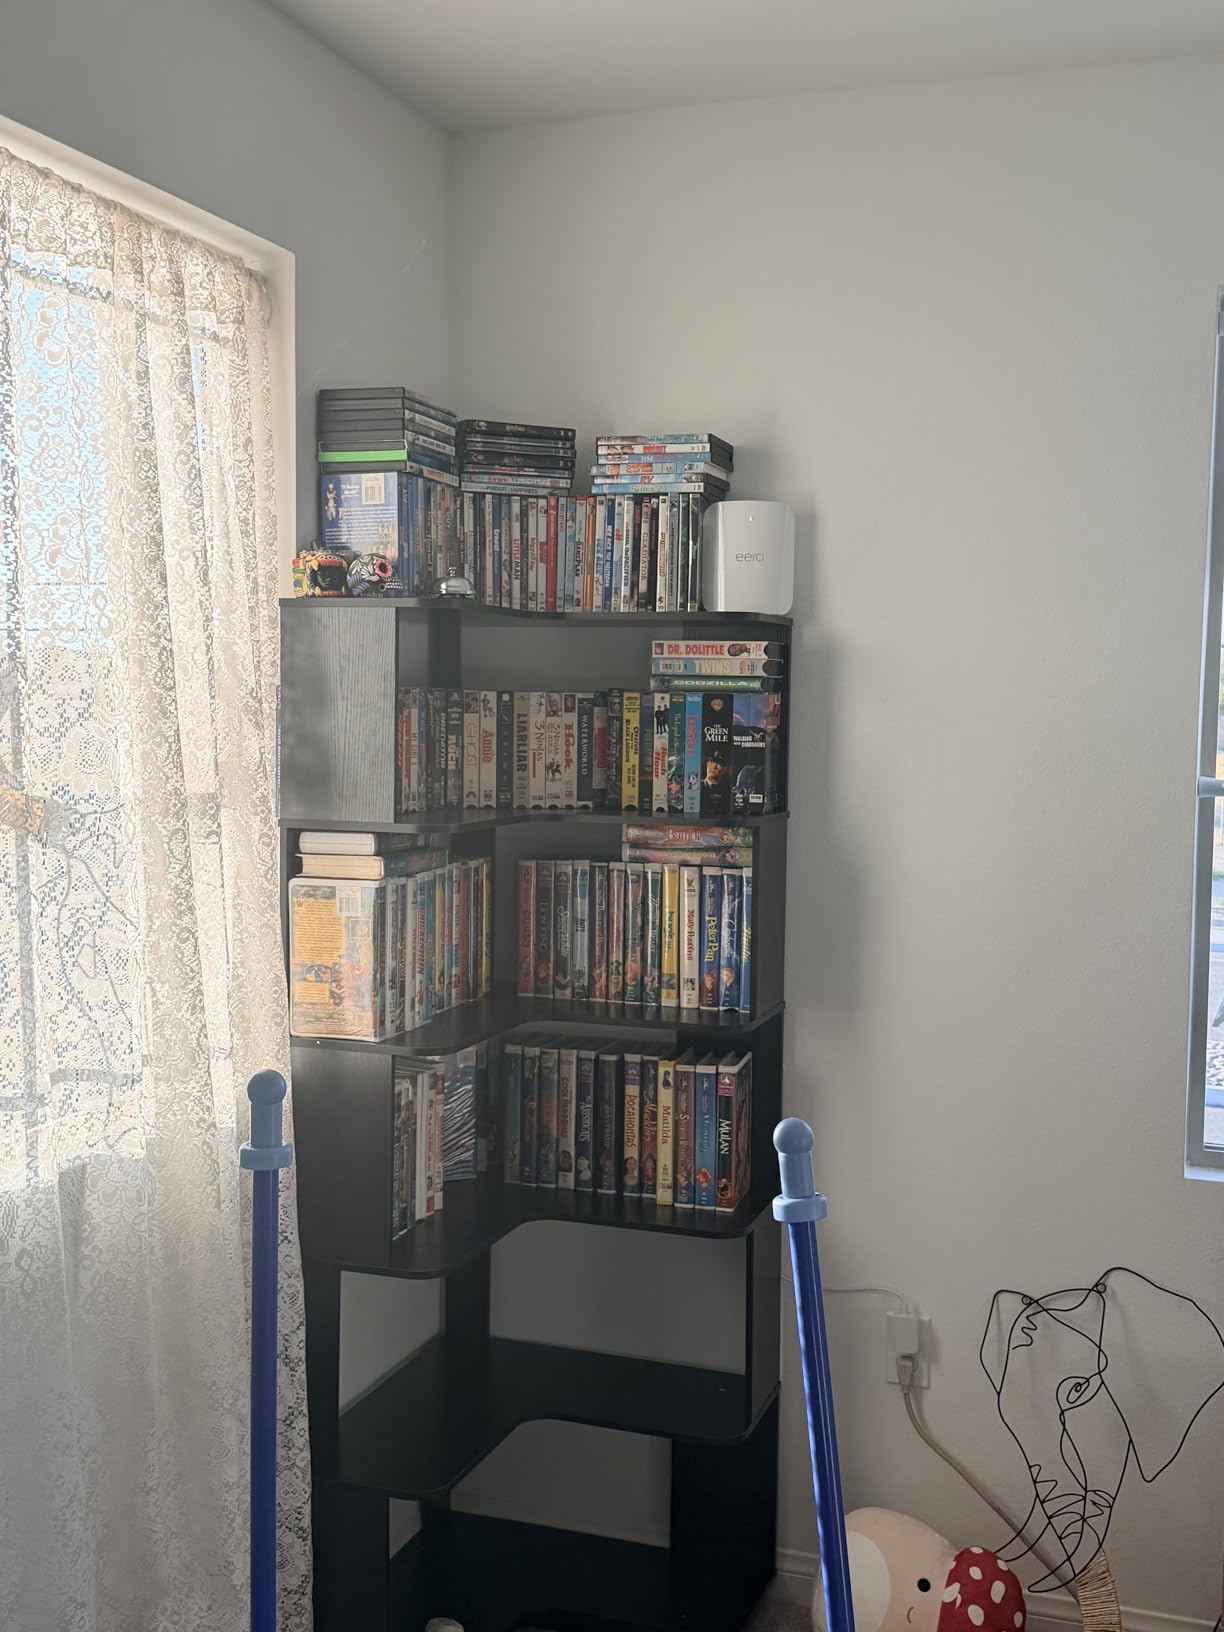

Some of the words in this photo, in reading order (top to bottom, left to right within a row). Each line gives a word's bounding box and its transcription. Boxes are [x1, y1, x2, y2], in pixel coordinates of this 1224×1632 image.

[641, 532, 649, 581] GLADIATOR
[736, 552, 765, 562] eero
[667, 644, 682, 656] DR.
[685, 644, 725, 656] DOLITTLE
[694, 659, 730, 674] TWINS
[516, 713, 528, 743] LIAR
[535, 721, 545, 731] 3
[704, 726, 729, 735] GREEN
[705, 734, 730, 743] MILE
[448, 735, 457, 769] ROCK
[467, 723, 477, 767] GHOST
[482, 730, 494, 763] Annie
[516, 744, 528, 772] LIAR
[531, 732, 545, 762] NINJAS
[552, 731, 561, 756] NINJAS
[564, 721, 575, 771] Hook
[660, 747, 668, 776] Rush
[687, 909, 695, 929] Mary
[704, 916, 718, 942] Peter
[686, 931, 696, 961] Poppins
[704, 943, 719, 962] Pan
[723, 920, 737, 958] Cinderella
[561, 1077, 570, 1098] COOL
[625, 1095, 638, 1147] POCAHONTAS
[661, 1105, 672, 1144] Matilda
[719, 1118, 732, 1155] MULAN
